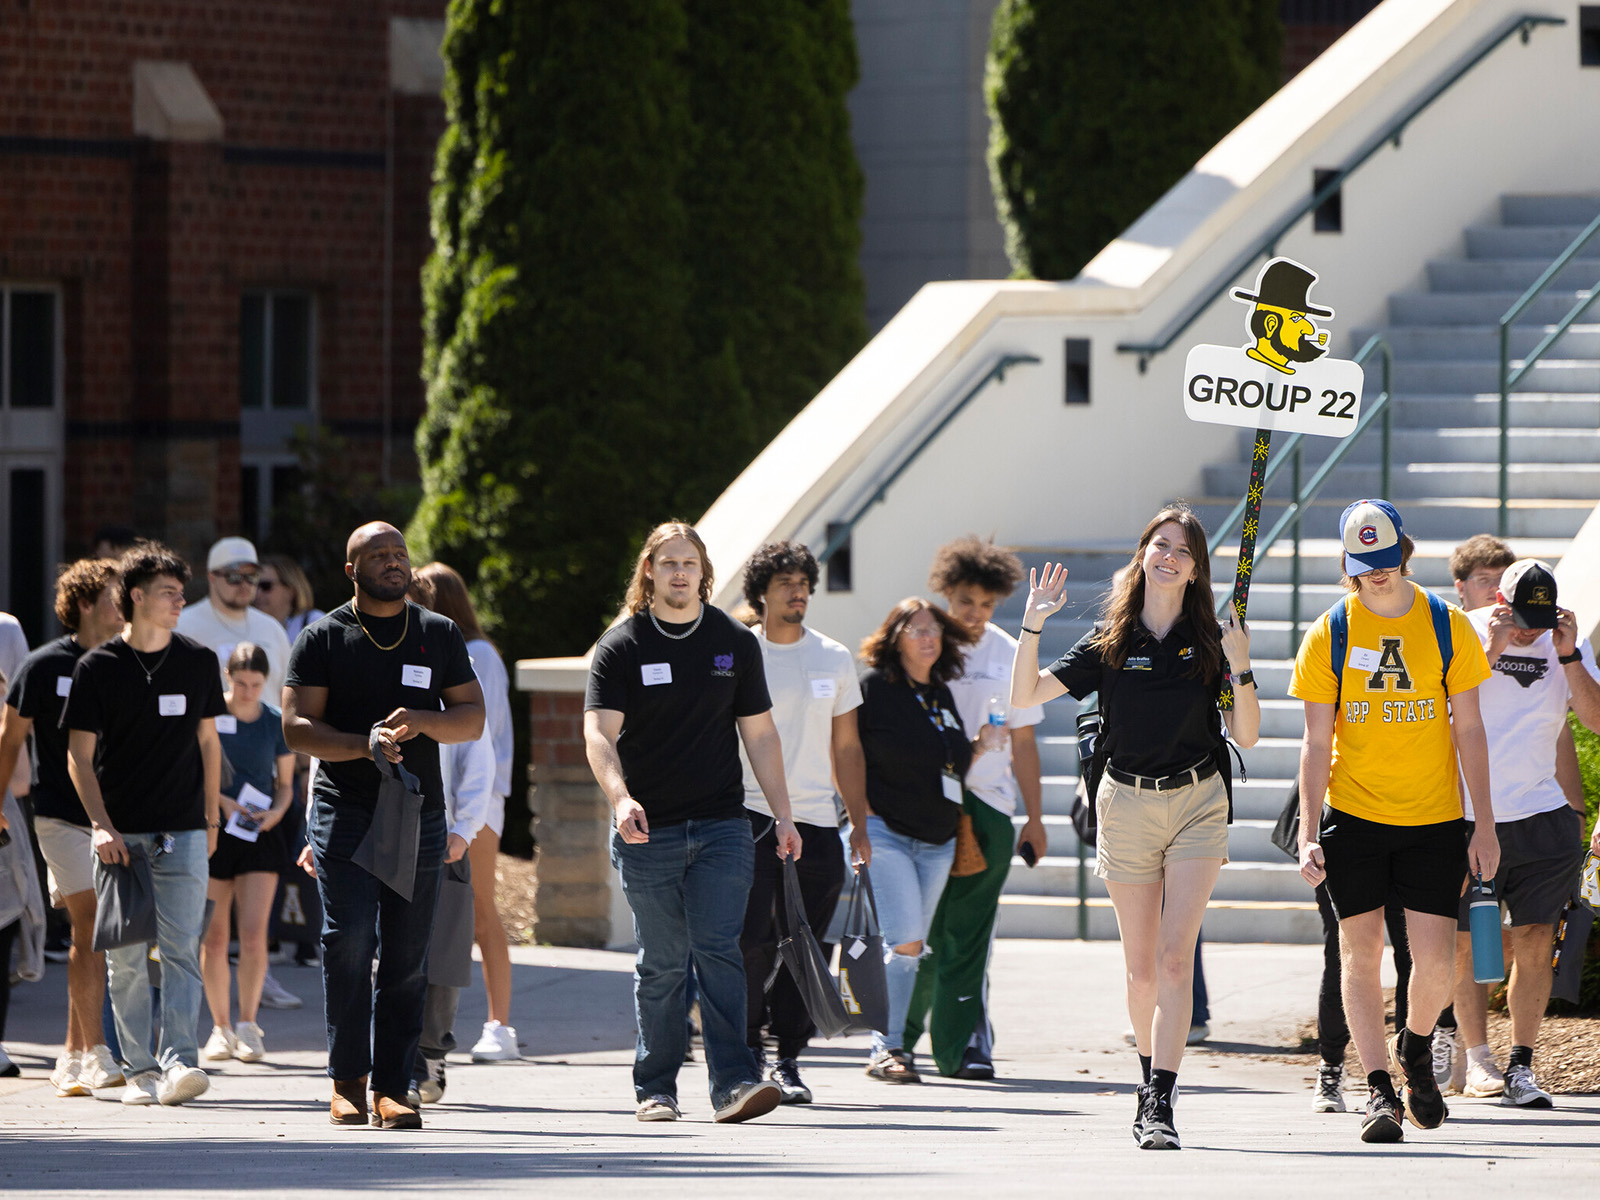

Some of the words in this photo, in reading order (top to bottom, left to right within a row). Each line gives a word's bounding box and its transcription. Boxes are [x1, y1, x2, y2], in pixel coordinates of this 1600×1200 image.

[1188, 374, 1312, 413] GROUP
[1317, 389, 1357, 420] 22
[1365, 635, 1415, 692] A
[1346, 701, 1370, 723] APP
[1383, 698, 1436, 723] STATE
